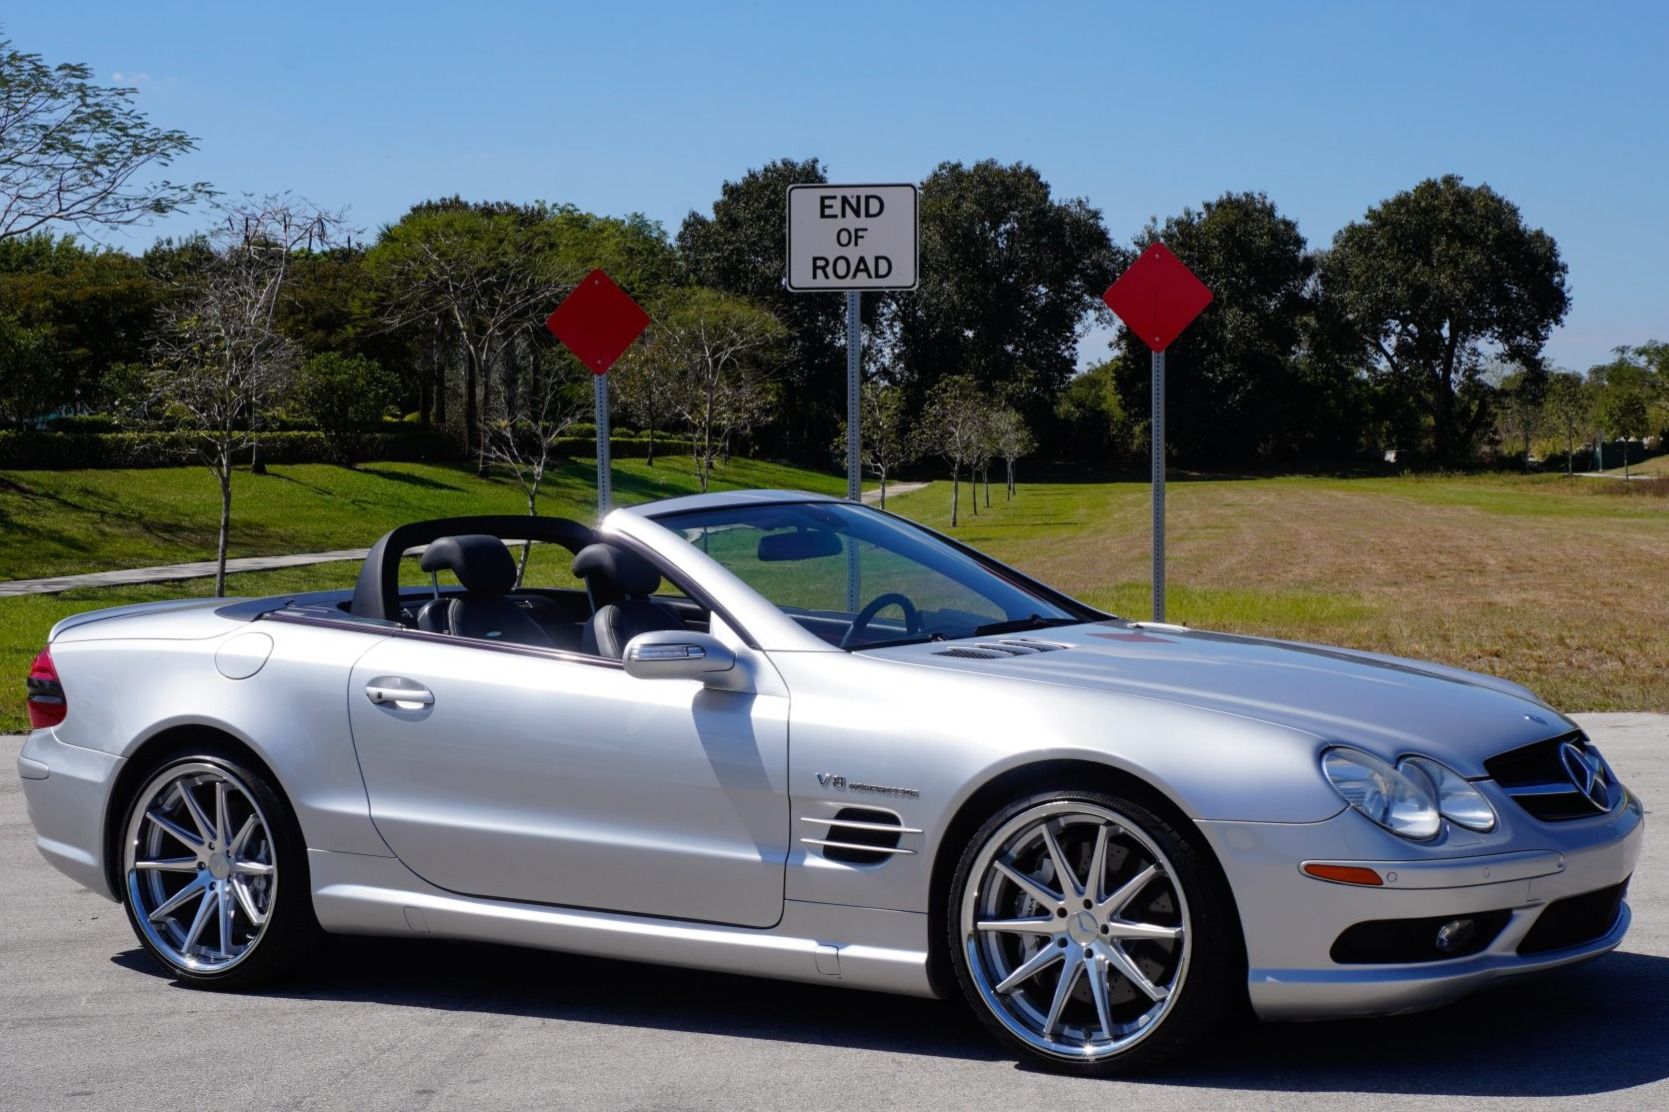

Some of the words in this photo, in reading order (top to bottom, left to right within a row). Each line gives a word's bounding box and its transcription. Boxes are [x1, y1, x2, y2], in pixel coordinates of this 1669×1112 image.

[820, 194, 885, 219] END
[836, 227, 868, 247] OF
[812, 255, 893, 280] ROAD
[816, 772, 846, 789] V8
